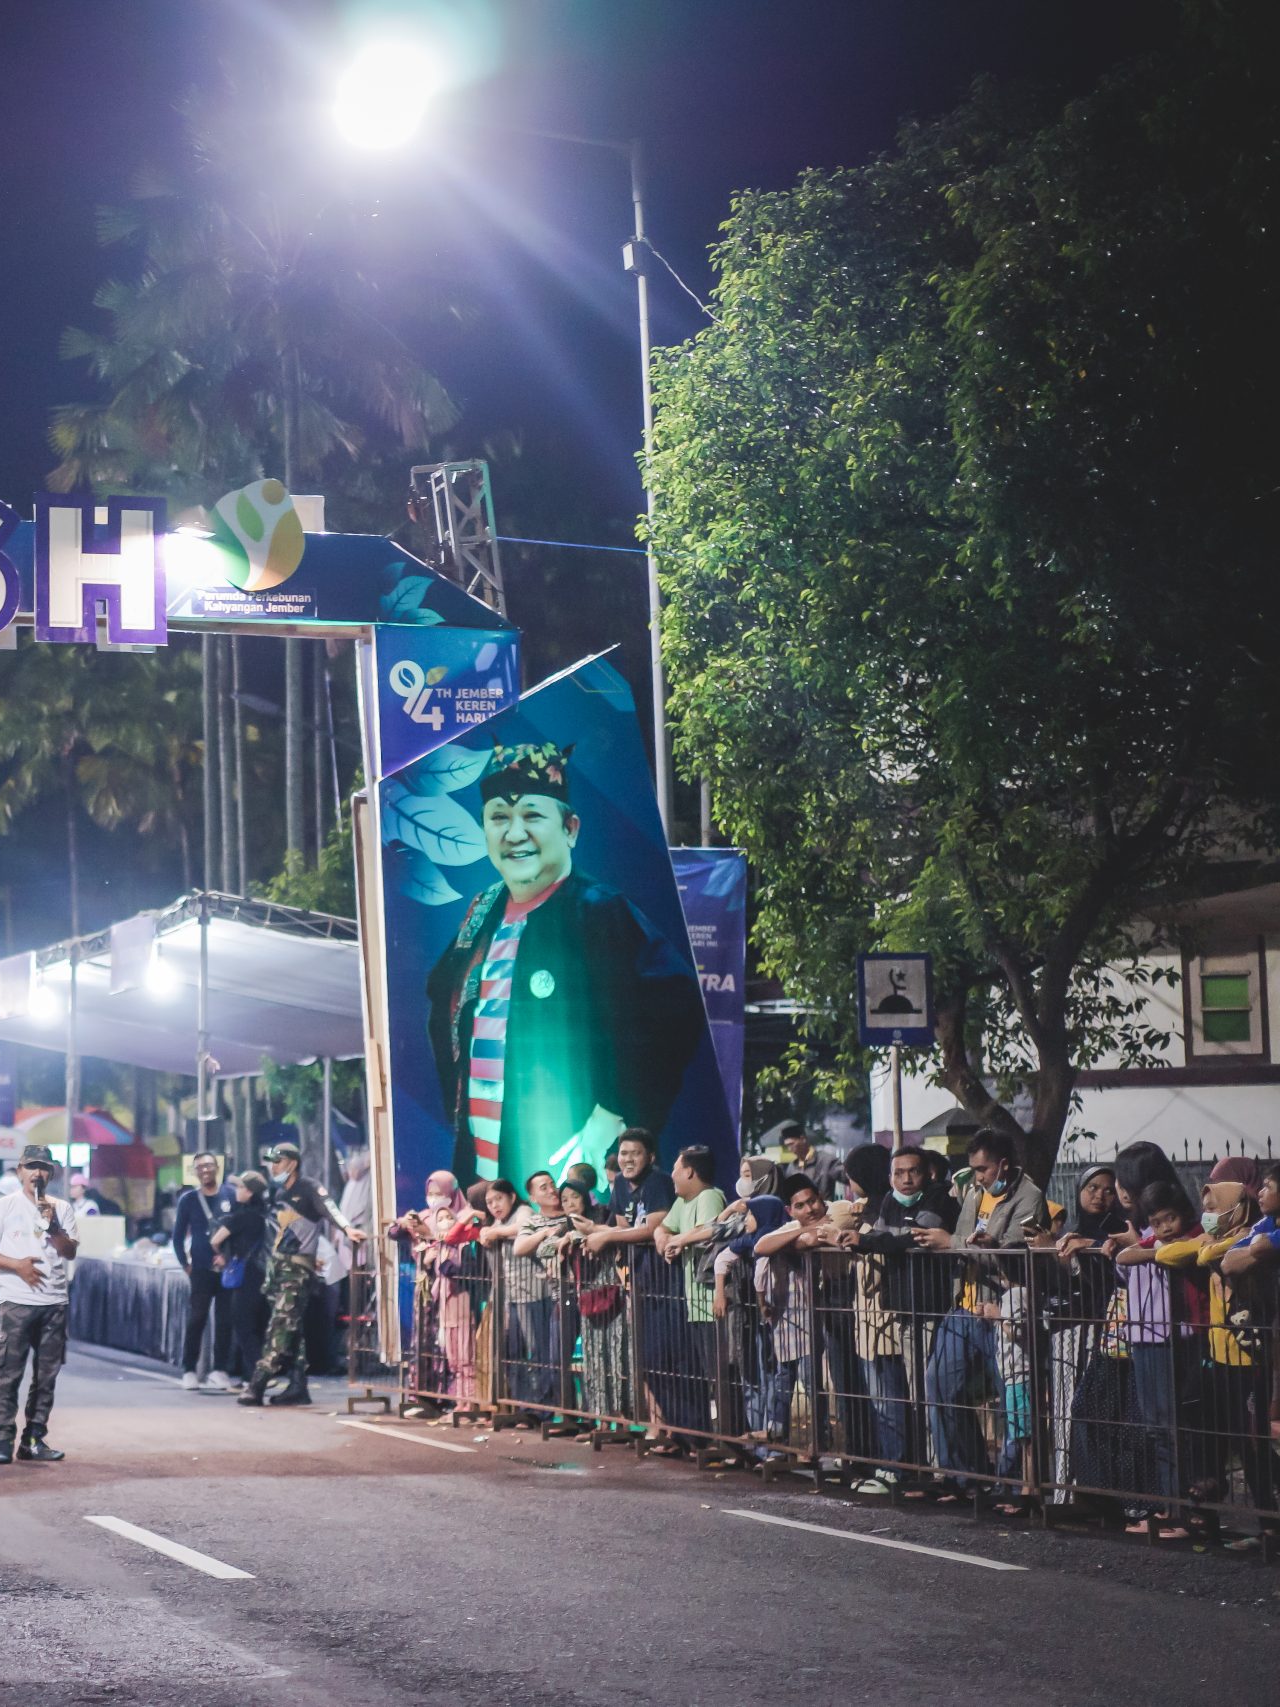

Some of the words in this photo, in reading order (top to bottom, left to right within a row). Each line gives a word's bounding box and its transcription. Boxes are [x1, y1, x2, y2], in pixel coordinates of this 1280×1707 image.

[248, 591, 312, 604] Perkebunan
[203, 600, 264, 615] Kahyangan
[265, 602, 306, 614] Jember
[455, 687, 504, 700] JEMBER
[455, 700, 496, 711] KEREN
